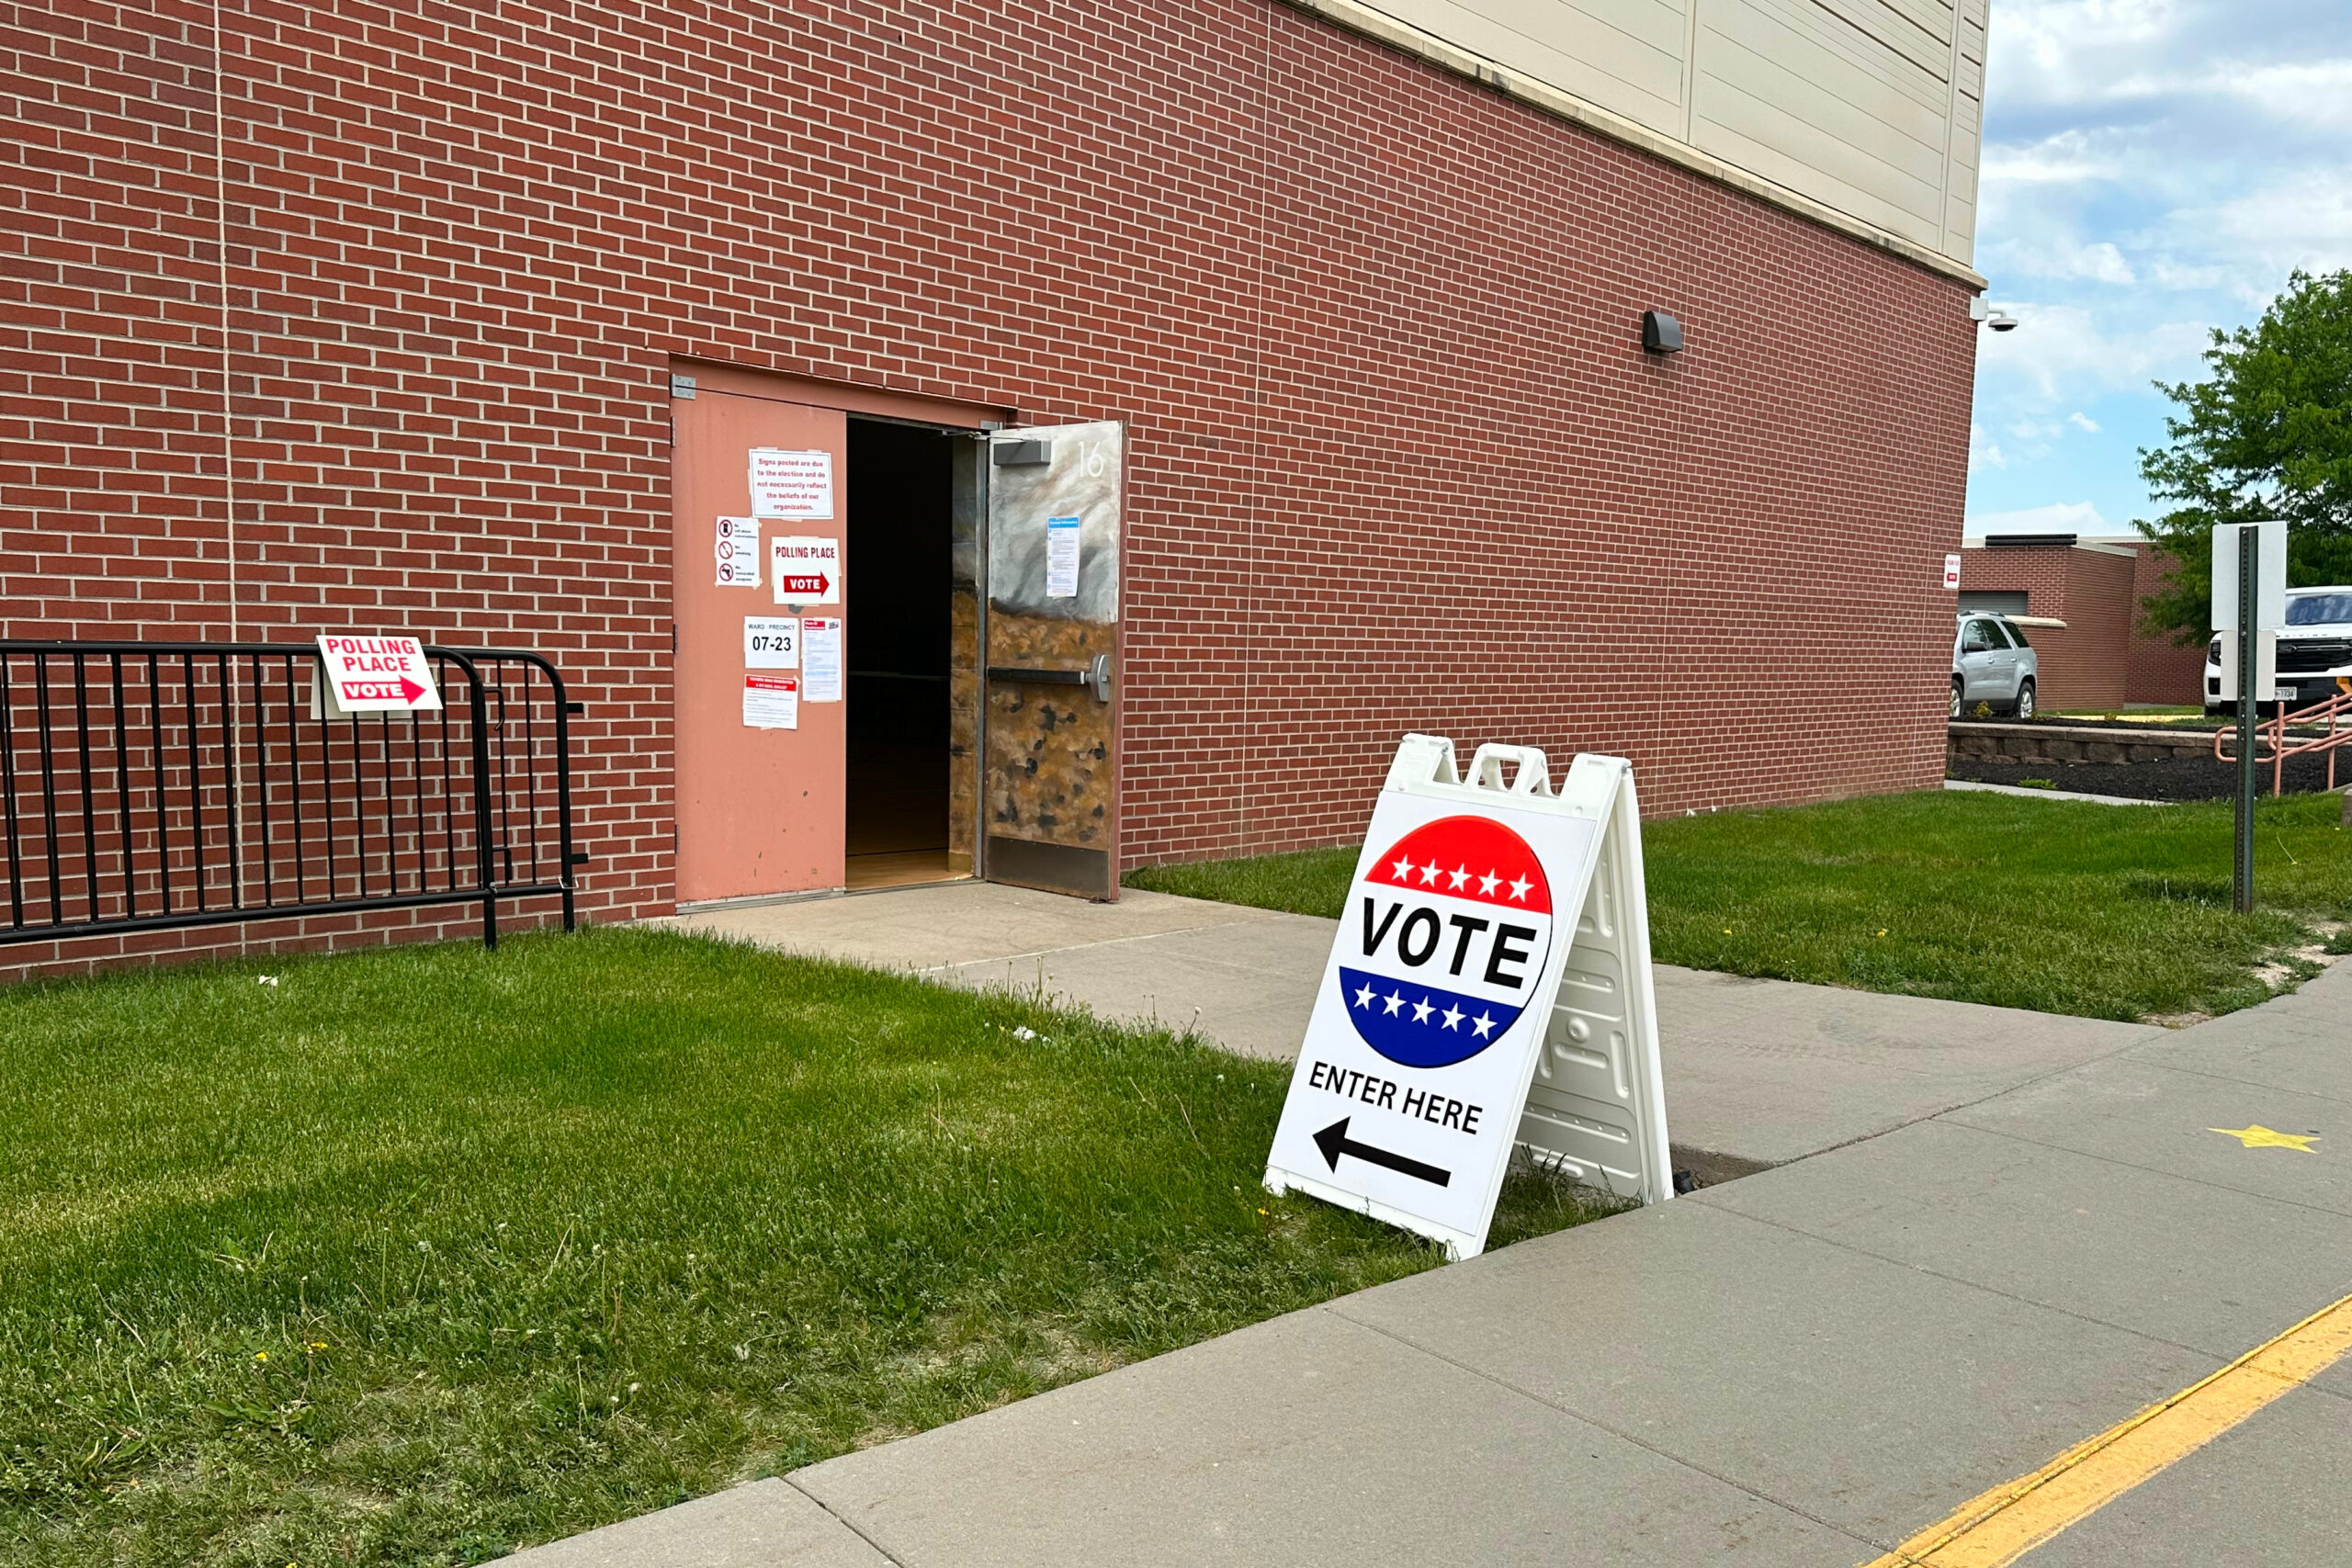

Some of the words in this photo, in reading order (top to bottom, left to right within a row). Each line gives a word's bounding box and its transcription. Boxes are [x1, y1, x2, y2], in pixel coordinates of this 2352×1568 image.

[758, 458, 775, 467] Signs
[1077, 440, 1103, 478] 16
[769, 481, 805, 490] necessarily
[773, 503, 813, 512] organization.
[775, 546, 808, 558] POLLING
[810, 547, 835, 558] PLACE
[789, 579, 820, 590] VOTE
[325, 638, 416, 654] POLLING
[752, 636, 791, 651] 07-23
[342, 657, 412, 671] PLACE
[344, 683, 405, 698] VOTE
[1362, 897, 1539, 990] VOTE
[1308, 1060, 1399, 1109] ENTER
[1401, 1087, 1484, 1136] HERE
